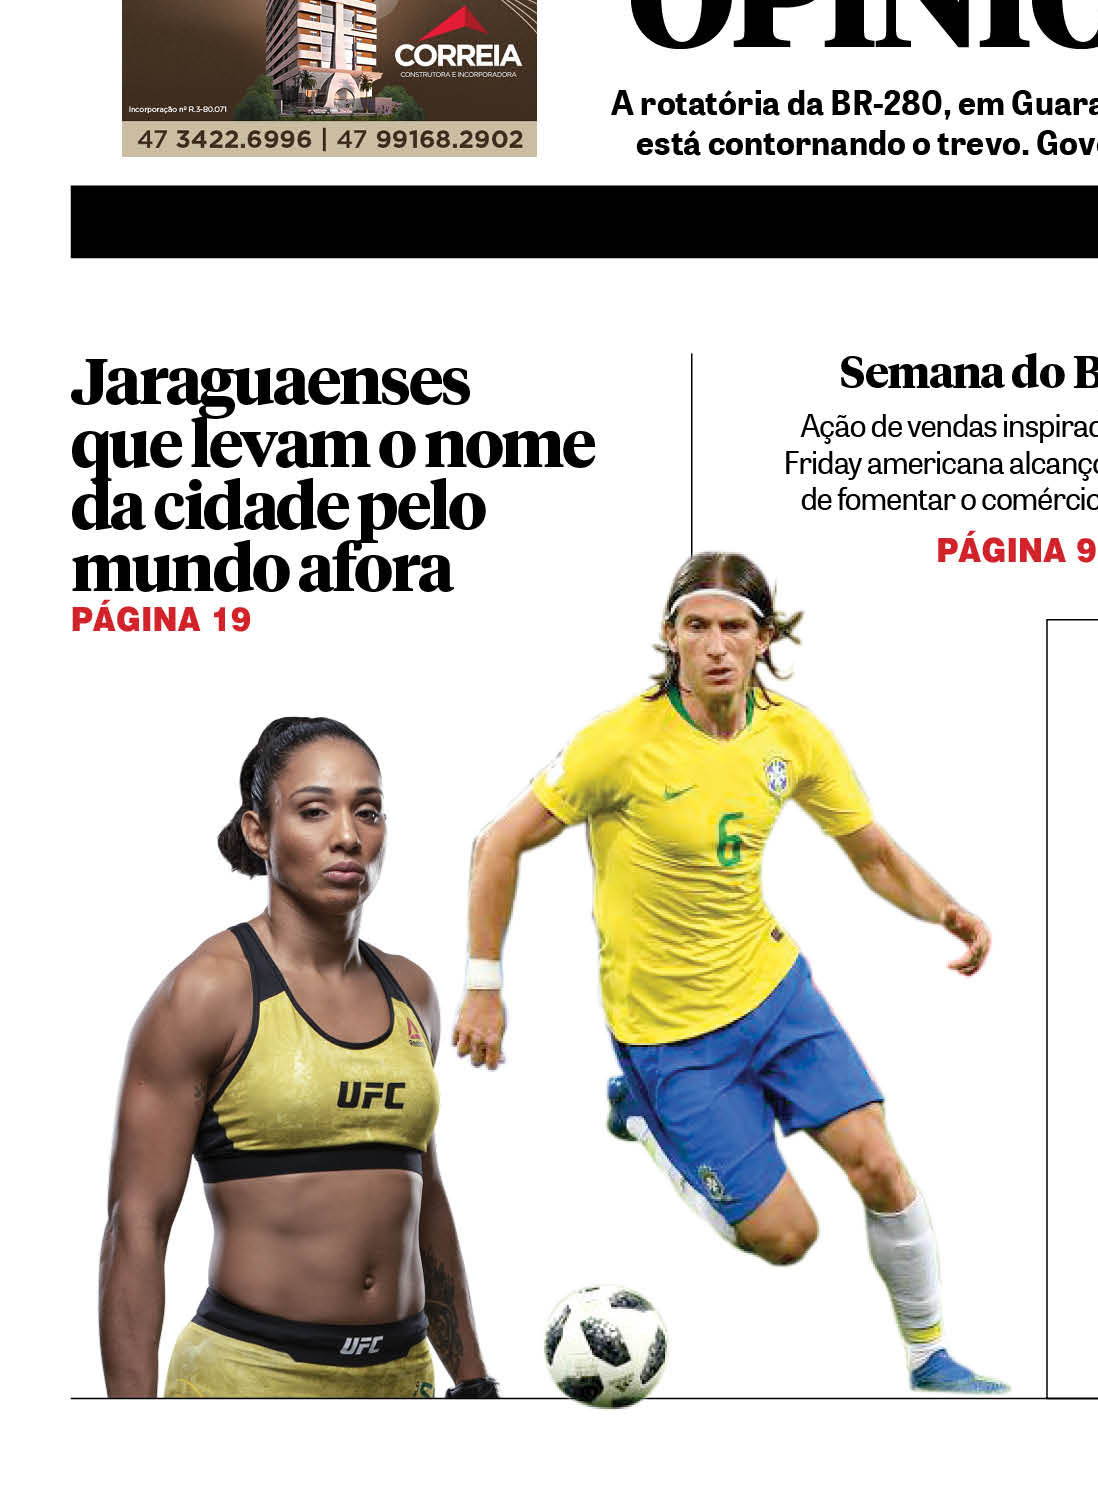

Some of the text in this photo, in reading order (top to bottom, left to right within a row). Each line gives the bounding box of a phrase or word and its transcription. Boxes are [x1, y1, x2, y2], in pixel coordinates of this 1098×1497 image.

[394, 43, 523, 67] CORREIA
[610, 89, 635, 116] A
[640, 89, 781, 117] rotatória
[787, 89, 825, 117] da
[831, 89, 951, 121] BR-280,
[958, 97, 1005, 116] em
[137, 129, 523, 149] 47 3422.6996 47 99168.2902
[636, 129, 702, 157] está
[708, 129, 906, 157] contornando
[912, 137, 931, 156] o
[936, 132, 1029, 156] trevo.
[840, 355, 1006, 389] Semana
[1011, 352, 1066, 389] do
[71, 358, 470, 418] Jaraguaenses
[800, 413, 866, 445] Ação
[871, 413, 903, 438] de
[906, 413, 998, 438] vendas
[72, 414, 596, 482] que levam o nome
[785, 450, 863, 481] Friday
[867, 450, 1005, 475] americana
[71, 476, 486, 543] da cidade pelo
[801, 486, 833, 511] de
[837, 486, 957, 511] fomentar
[960, 493, 977, 511] o
[937, 530, 1097, 564] PÁGINA 9
[71, 539, 454, 593] mundo afora
[71, 600, 251, 633] PÁGINA 19
[715, 811, 744, 868] 6
[337, 1081, 406, 1110] UFC
[339, 1335, 384, 1356] UFC
